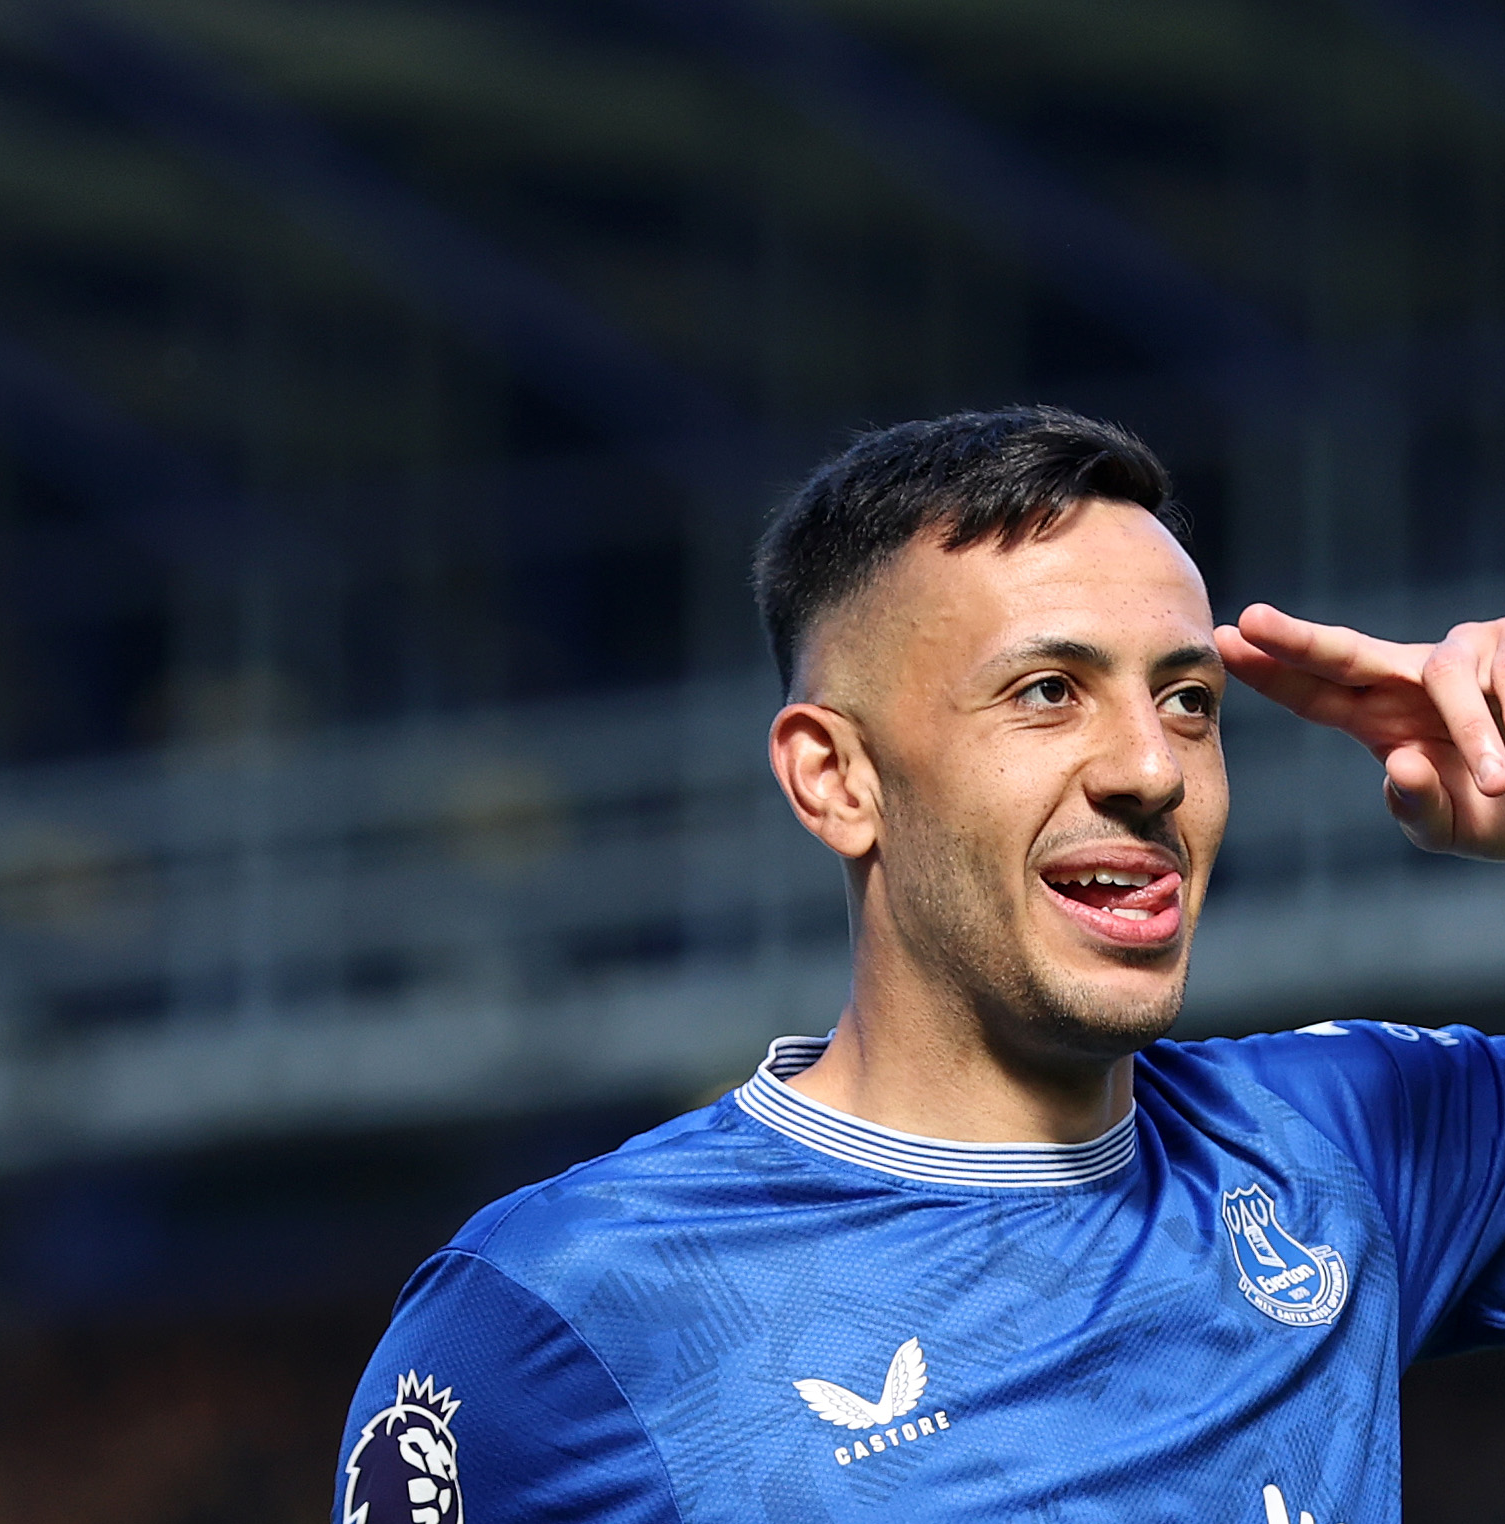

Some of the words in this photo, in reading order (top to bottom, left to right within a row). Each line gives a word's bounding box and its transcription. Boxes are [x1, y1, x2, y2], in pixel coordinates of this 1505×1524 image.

[1255, 1264, 1316, 1294] Everton
[1276, 1309, 1309, 1323] SATIS
[834, 1410, 951, 1466] CASTORE
